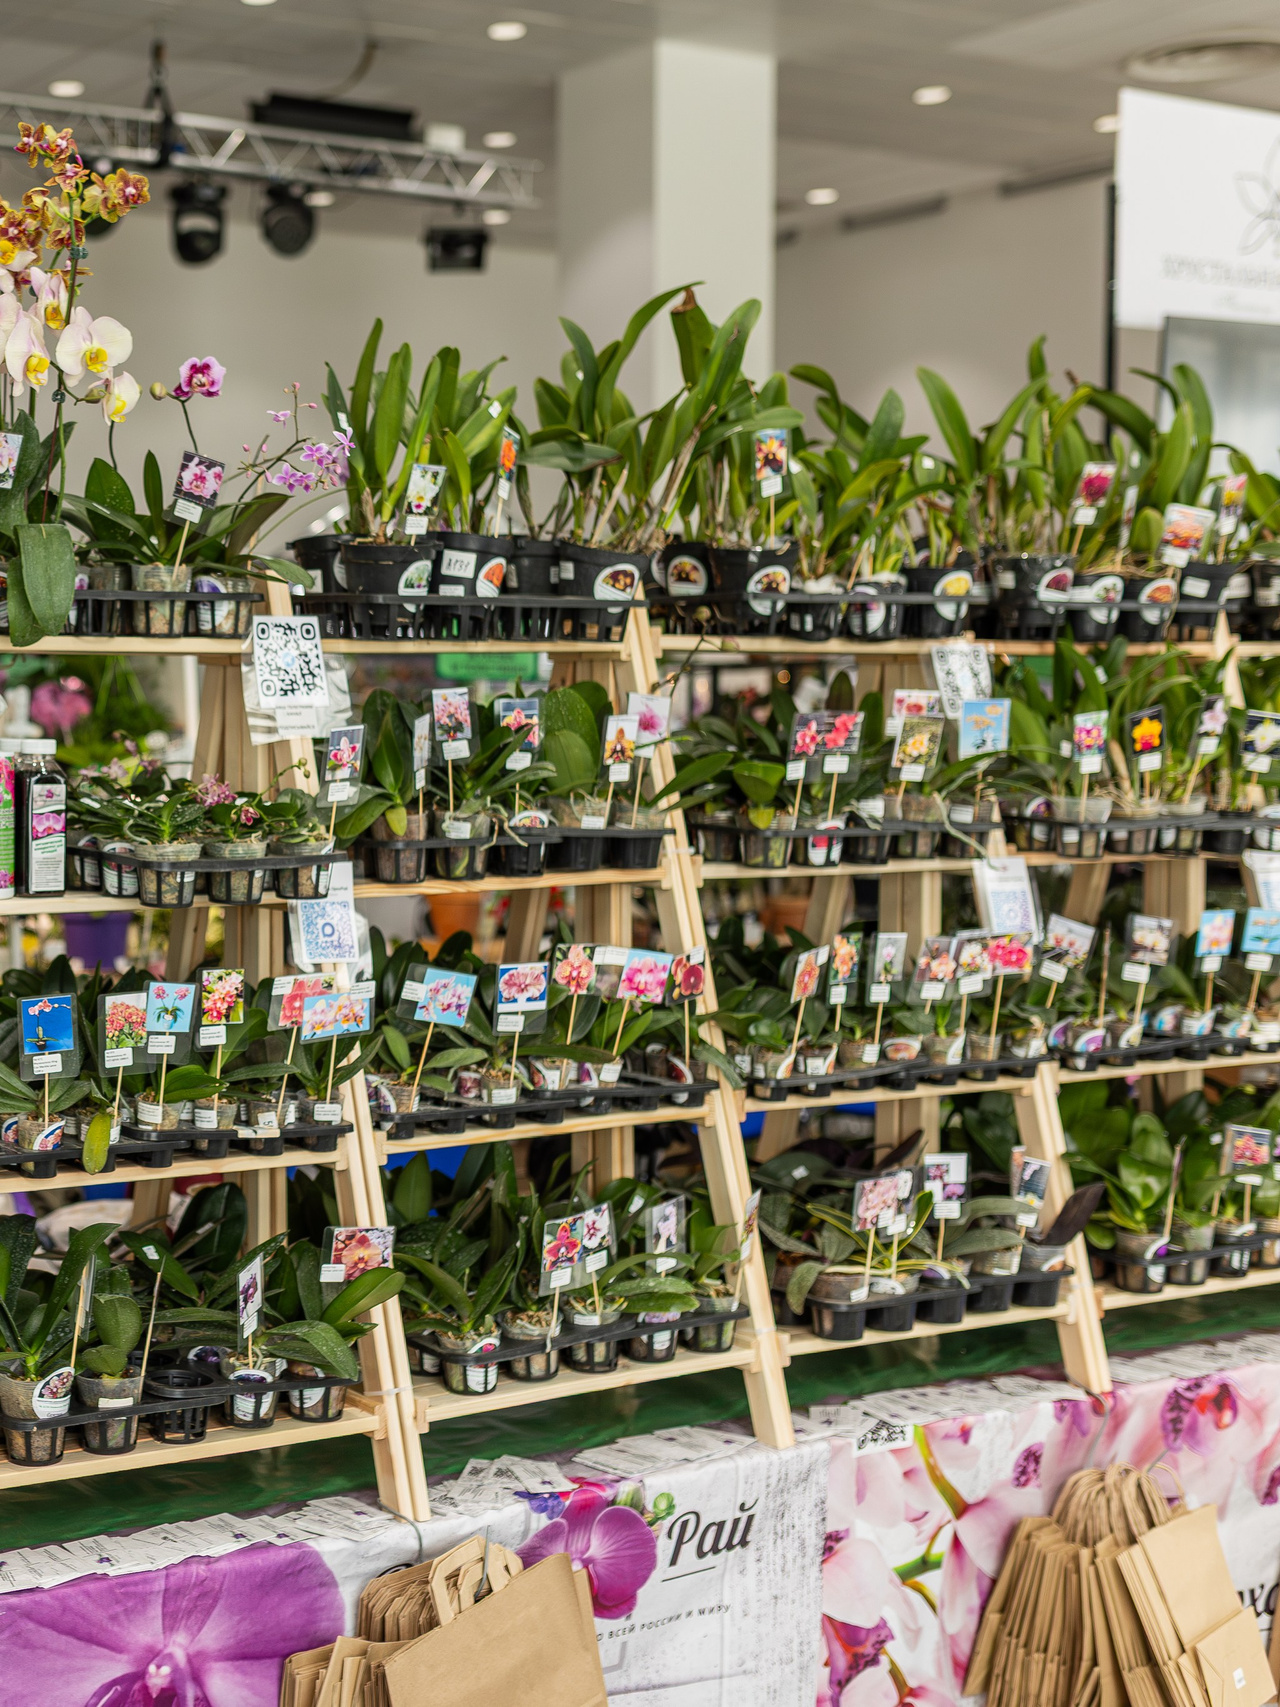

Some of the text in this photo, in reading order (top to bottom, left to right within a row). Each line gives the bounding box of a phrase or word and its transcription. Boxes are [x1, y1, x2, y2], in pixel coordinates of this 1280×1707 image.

[667, 1497, 759, 1568] Рай
[607, 1623, 636, 1639] ВСЕЙ
[640, 1612, 682, 1631] РОССИИ
[685, 1609, 693, 1619] И
[697, 1603, 732, 1617] МИРУ
